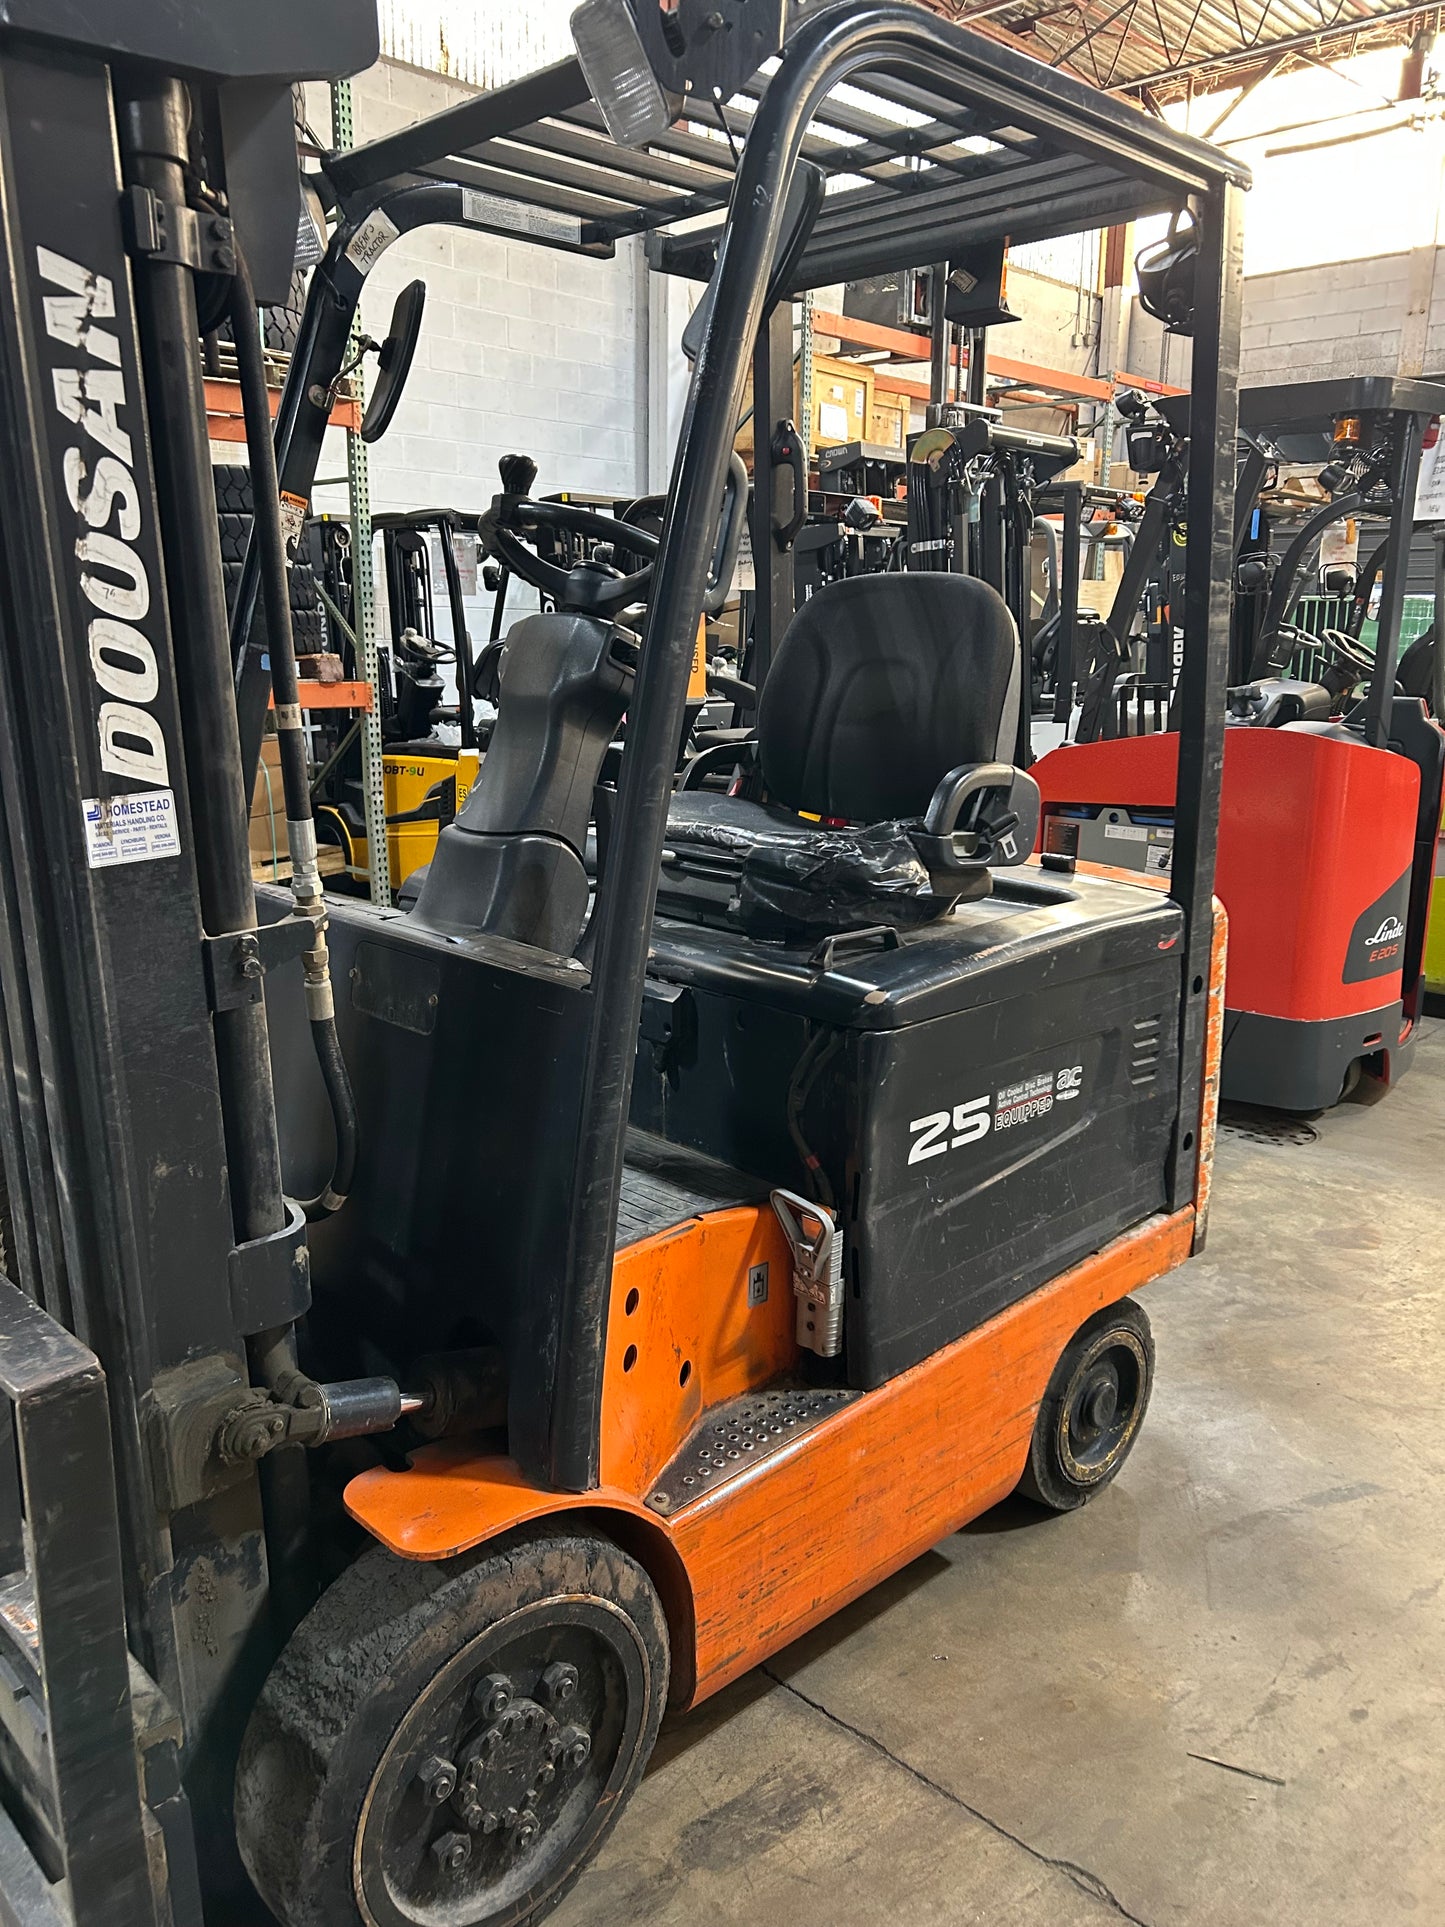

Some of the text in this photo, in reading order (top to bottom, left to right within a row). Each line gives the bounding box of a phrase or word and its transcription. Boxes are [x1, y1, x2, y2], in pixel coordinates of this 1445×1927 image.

[361, 231, 390, 265] TRACTOR
[825, 446, 848, 459] CROWN
[36, 245, 169, 786] DOOSAN
[458, 788, 467, 797] ES
[106, 799, 170, 817] HOMESTEAD
[95, 820, 126, 829] MATERIALS
[127, 817, 155, 826] HANDLING
[1364, 916, 1404, 946] Linde
[997, 1075, 1053, 1100] Oil Cooled Disc Brakes
[994, 1095, 1054, 1131] EQUIPPED
[907, 1095, 991, 1165] 25
